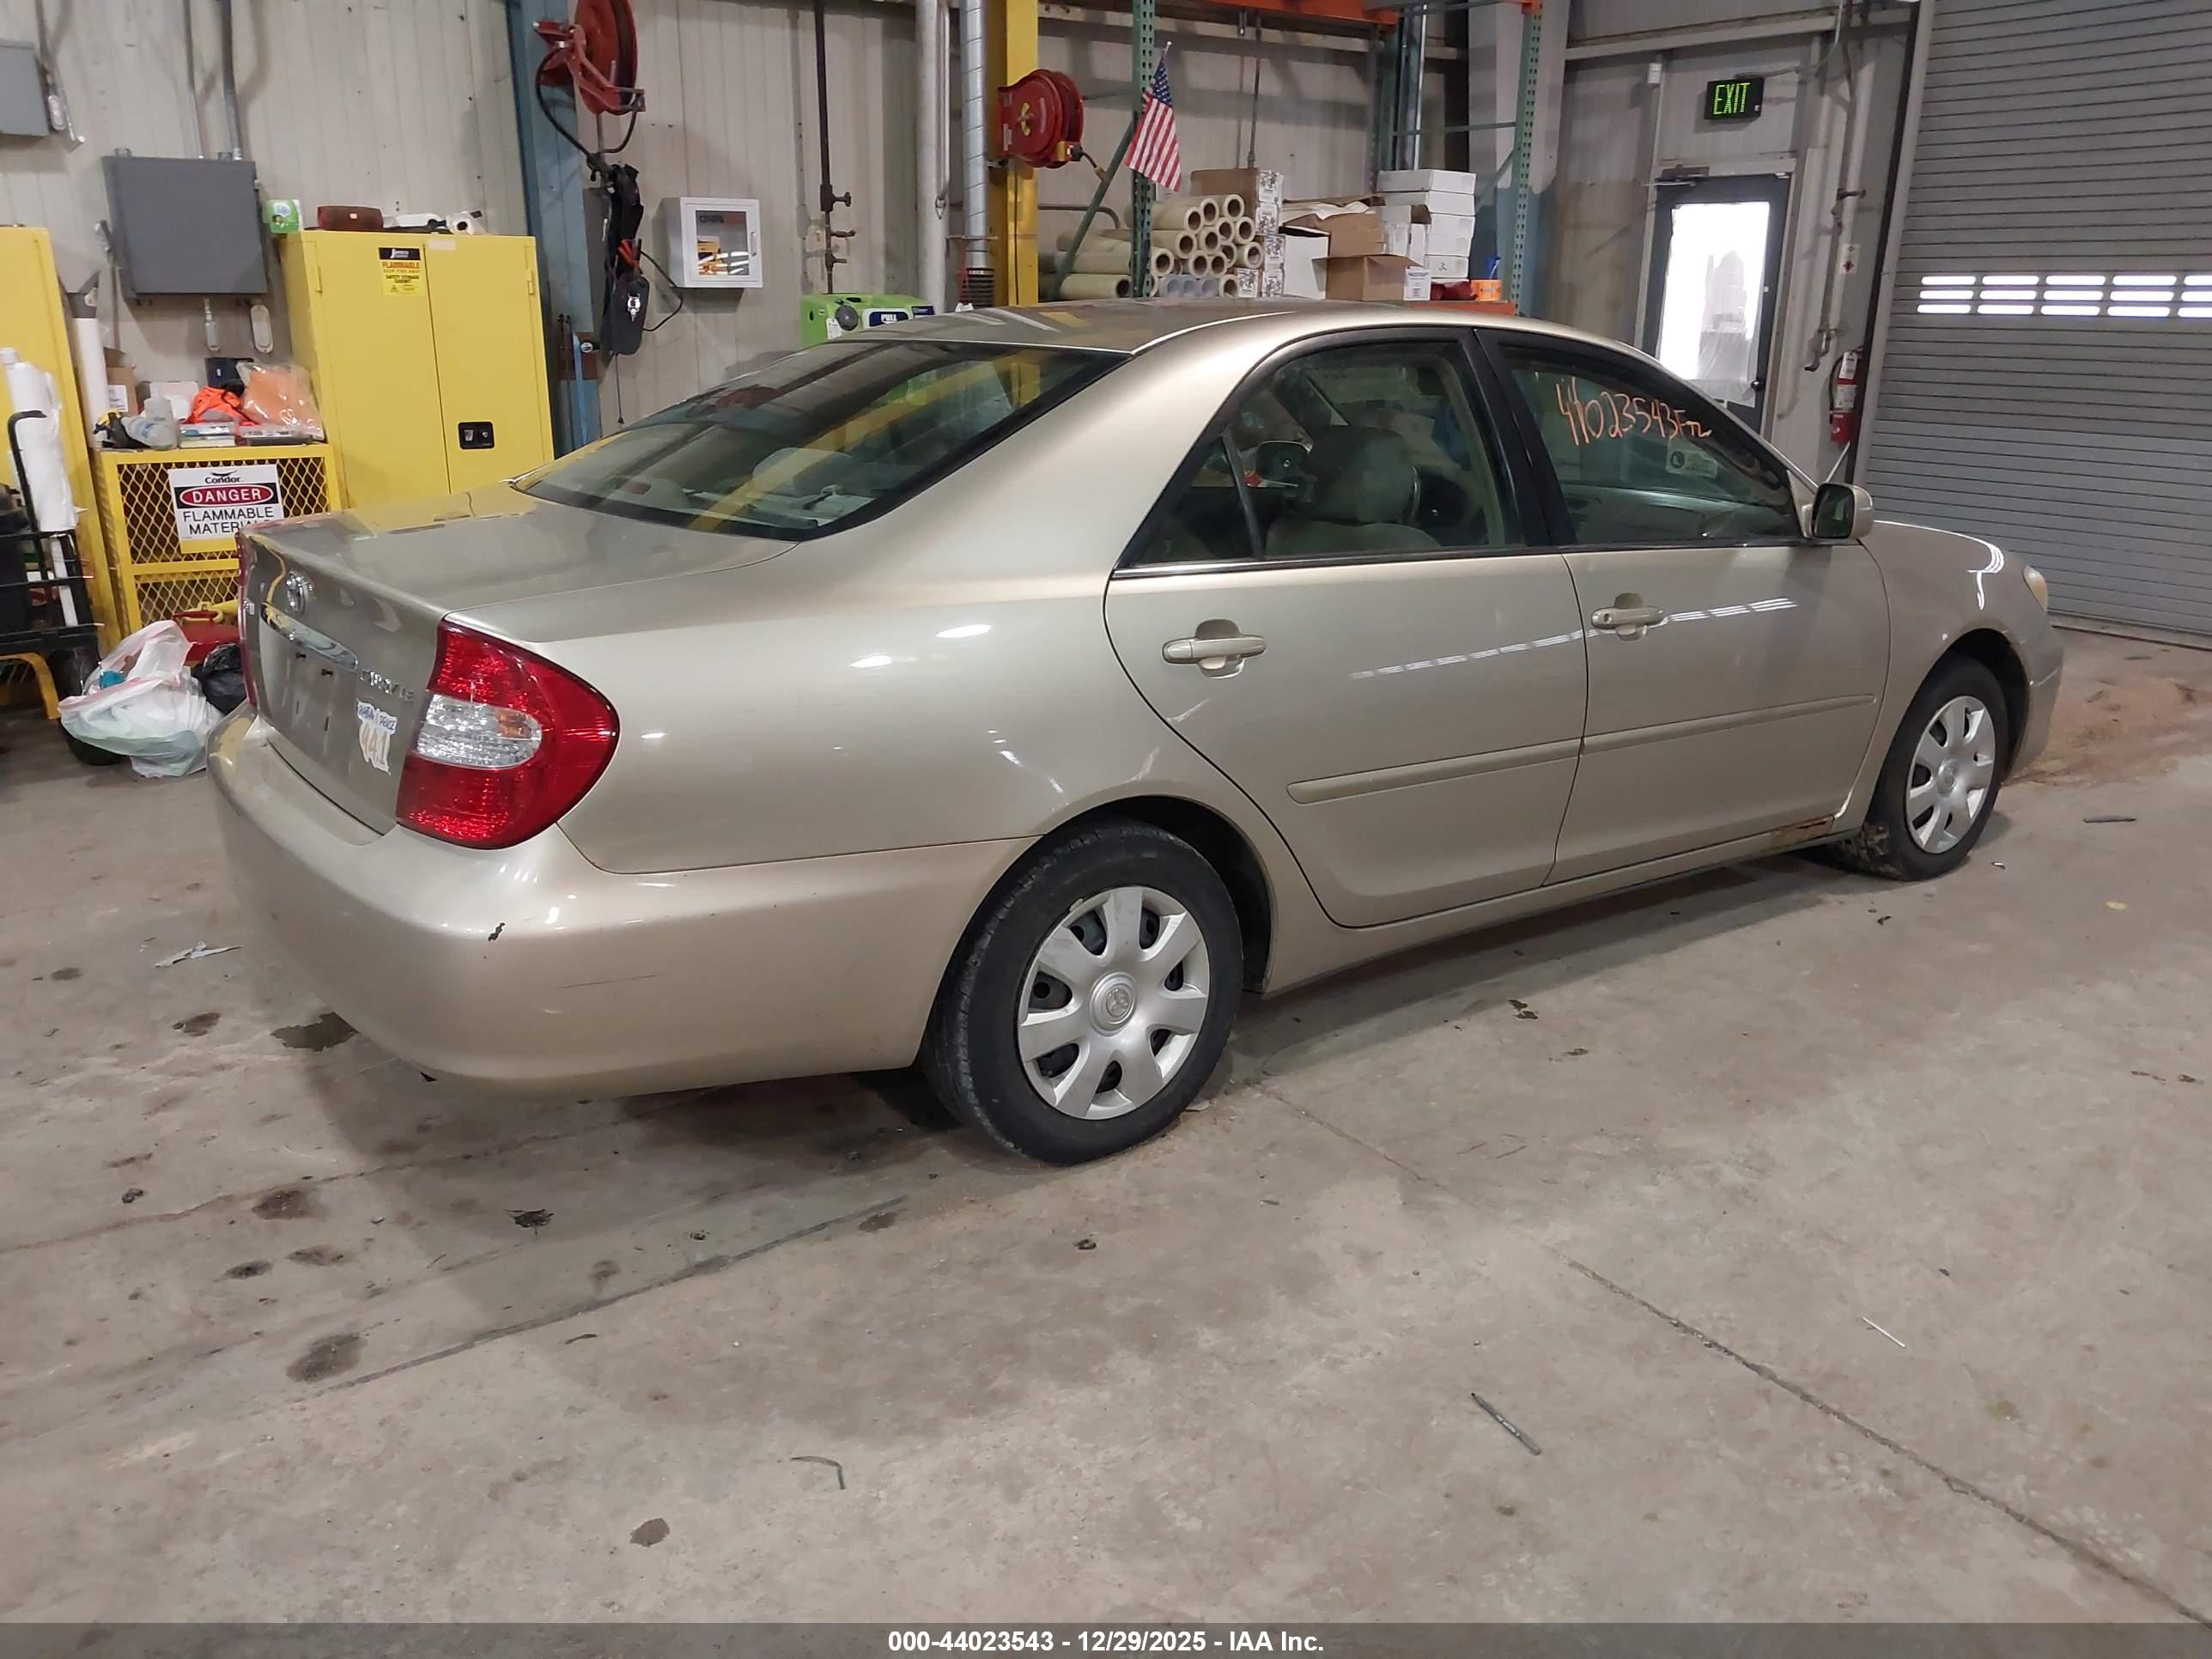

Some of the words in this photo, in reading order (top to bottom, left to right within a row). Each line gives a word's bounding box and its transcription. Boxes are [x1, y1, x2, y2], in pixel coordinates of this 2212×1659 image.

[1713, 82, 1751, 114] EXIT
[191, 489, 262, 503] DANGER
[183, 507, 275, 522] FLAMMABLE
